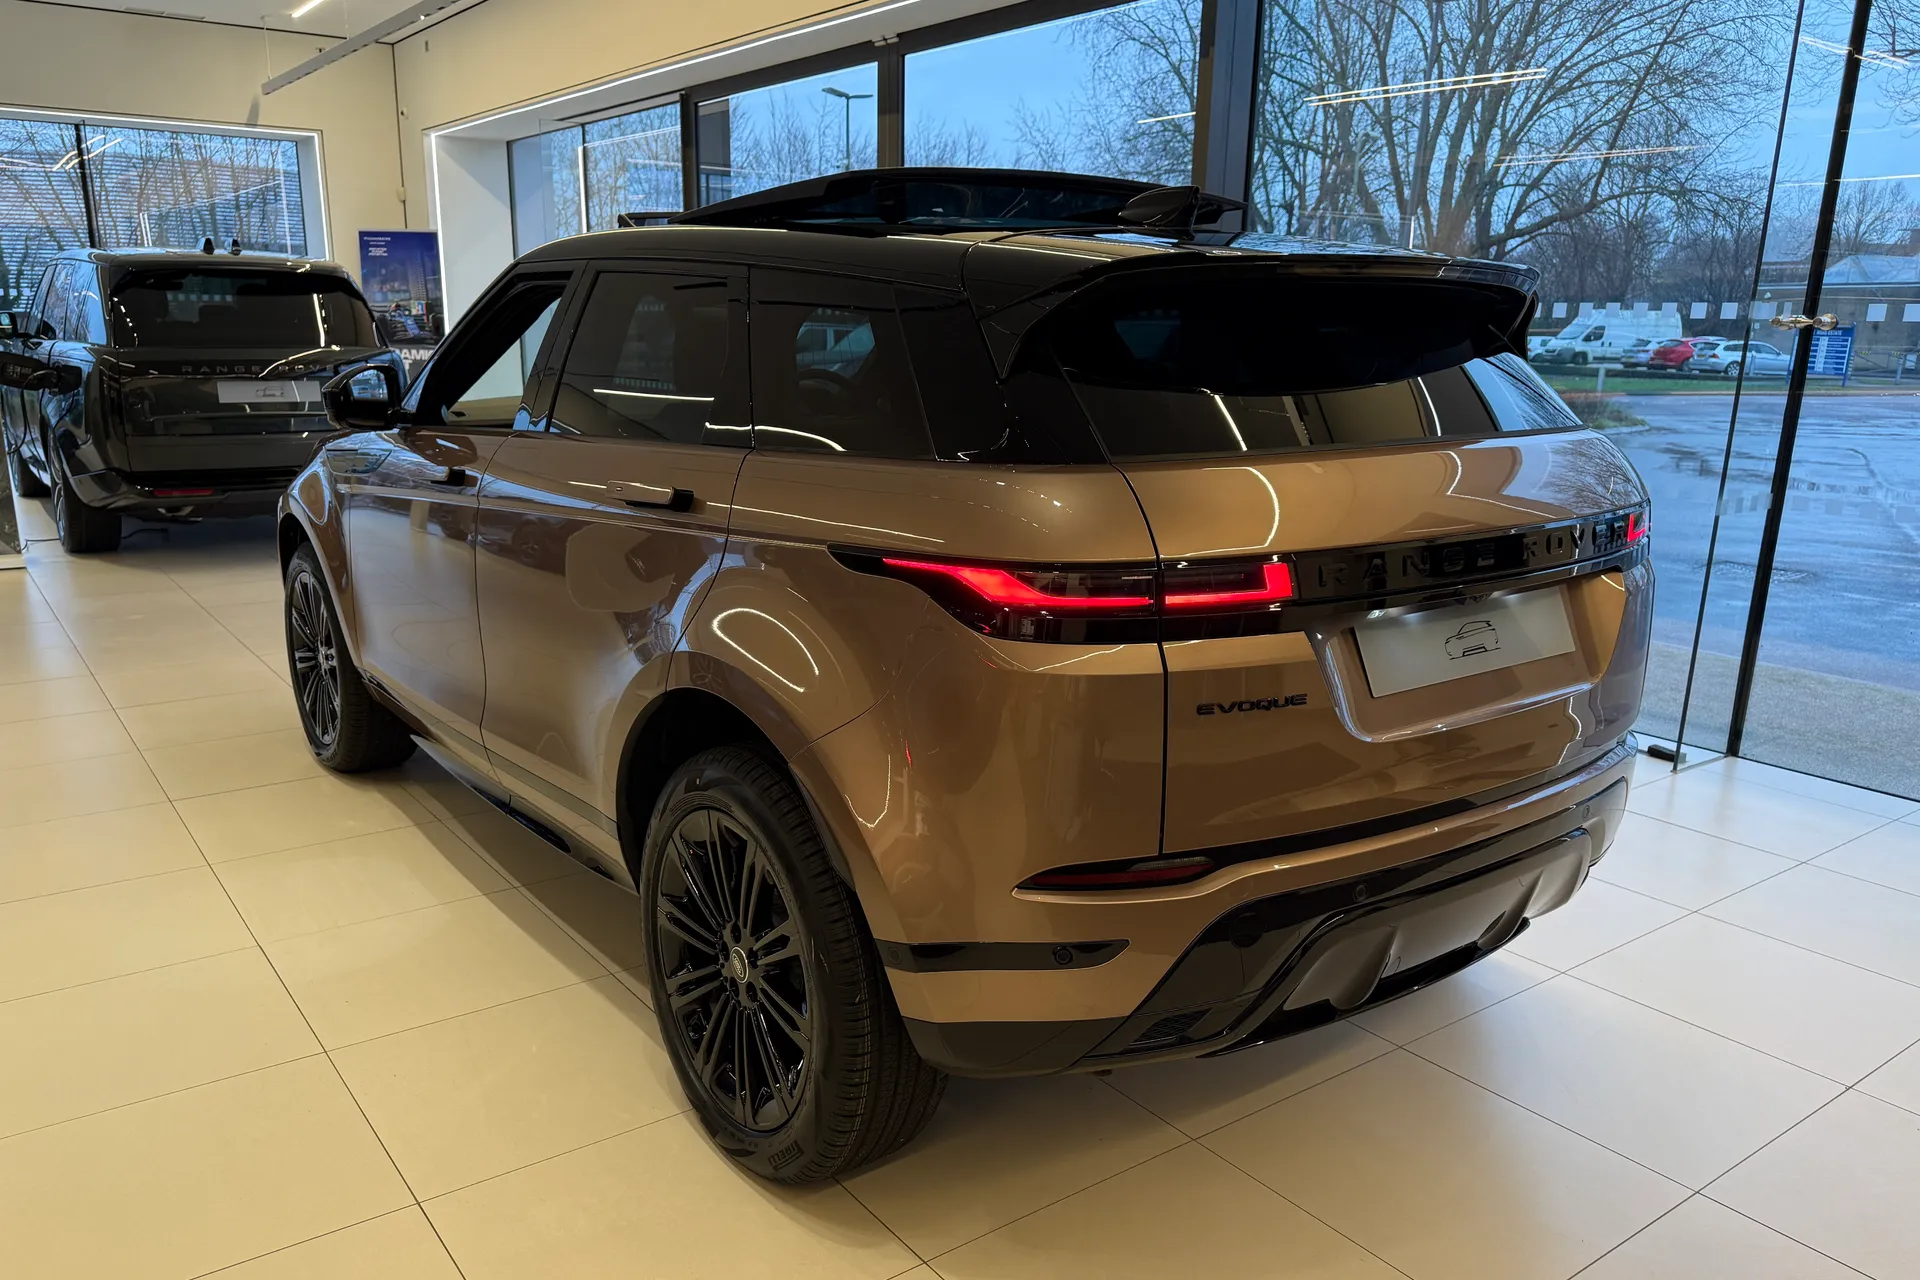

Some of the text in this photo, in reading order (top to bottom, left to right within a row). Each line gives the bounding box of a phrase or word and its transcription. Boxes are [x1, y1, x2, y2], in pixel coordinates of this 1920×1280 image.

[181, 364, 335, 373] RANGE ROVE
[1318, 519, 1626, 588] RANGE ROVER
[1196, 693, 1308, 716] EVOQUE
